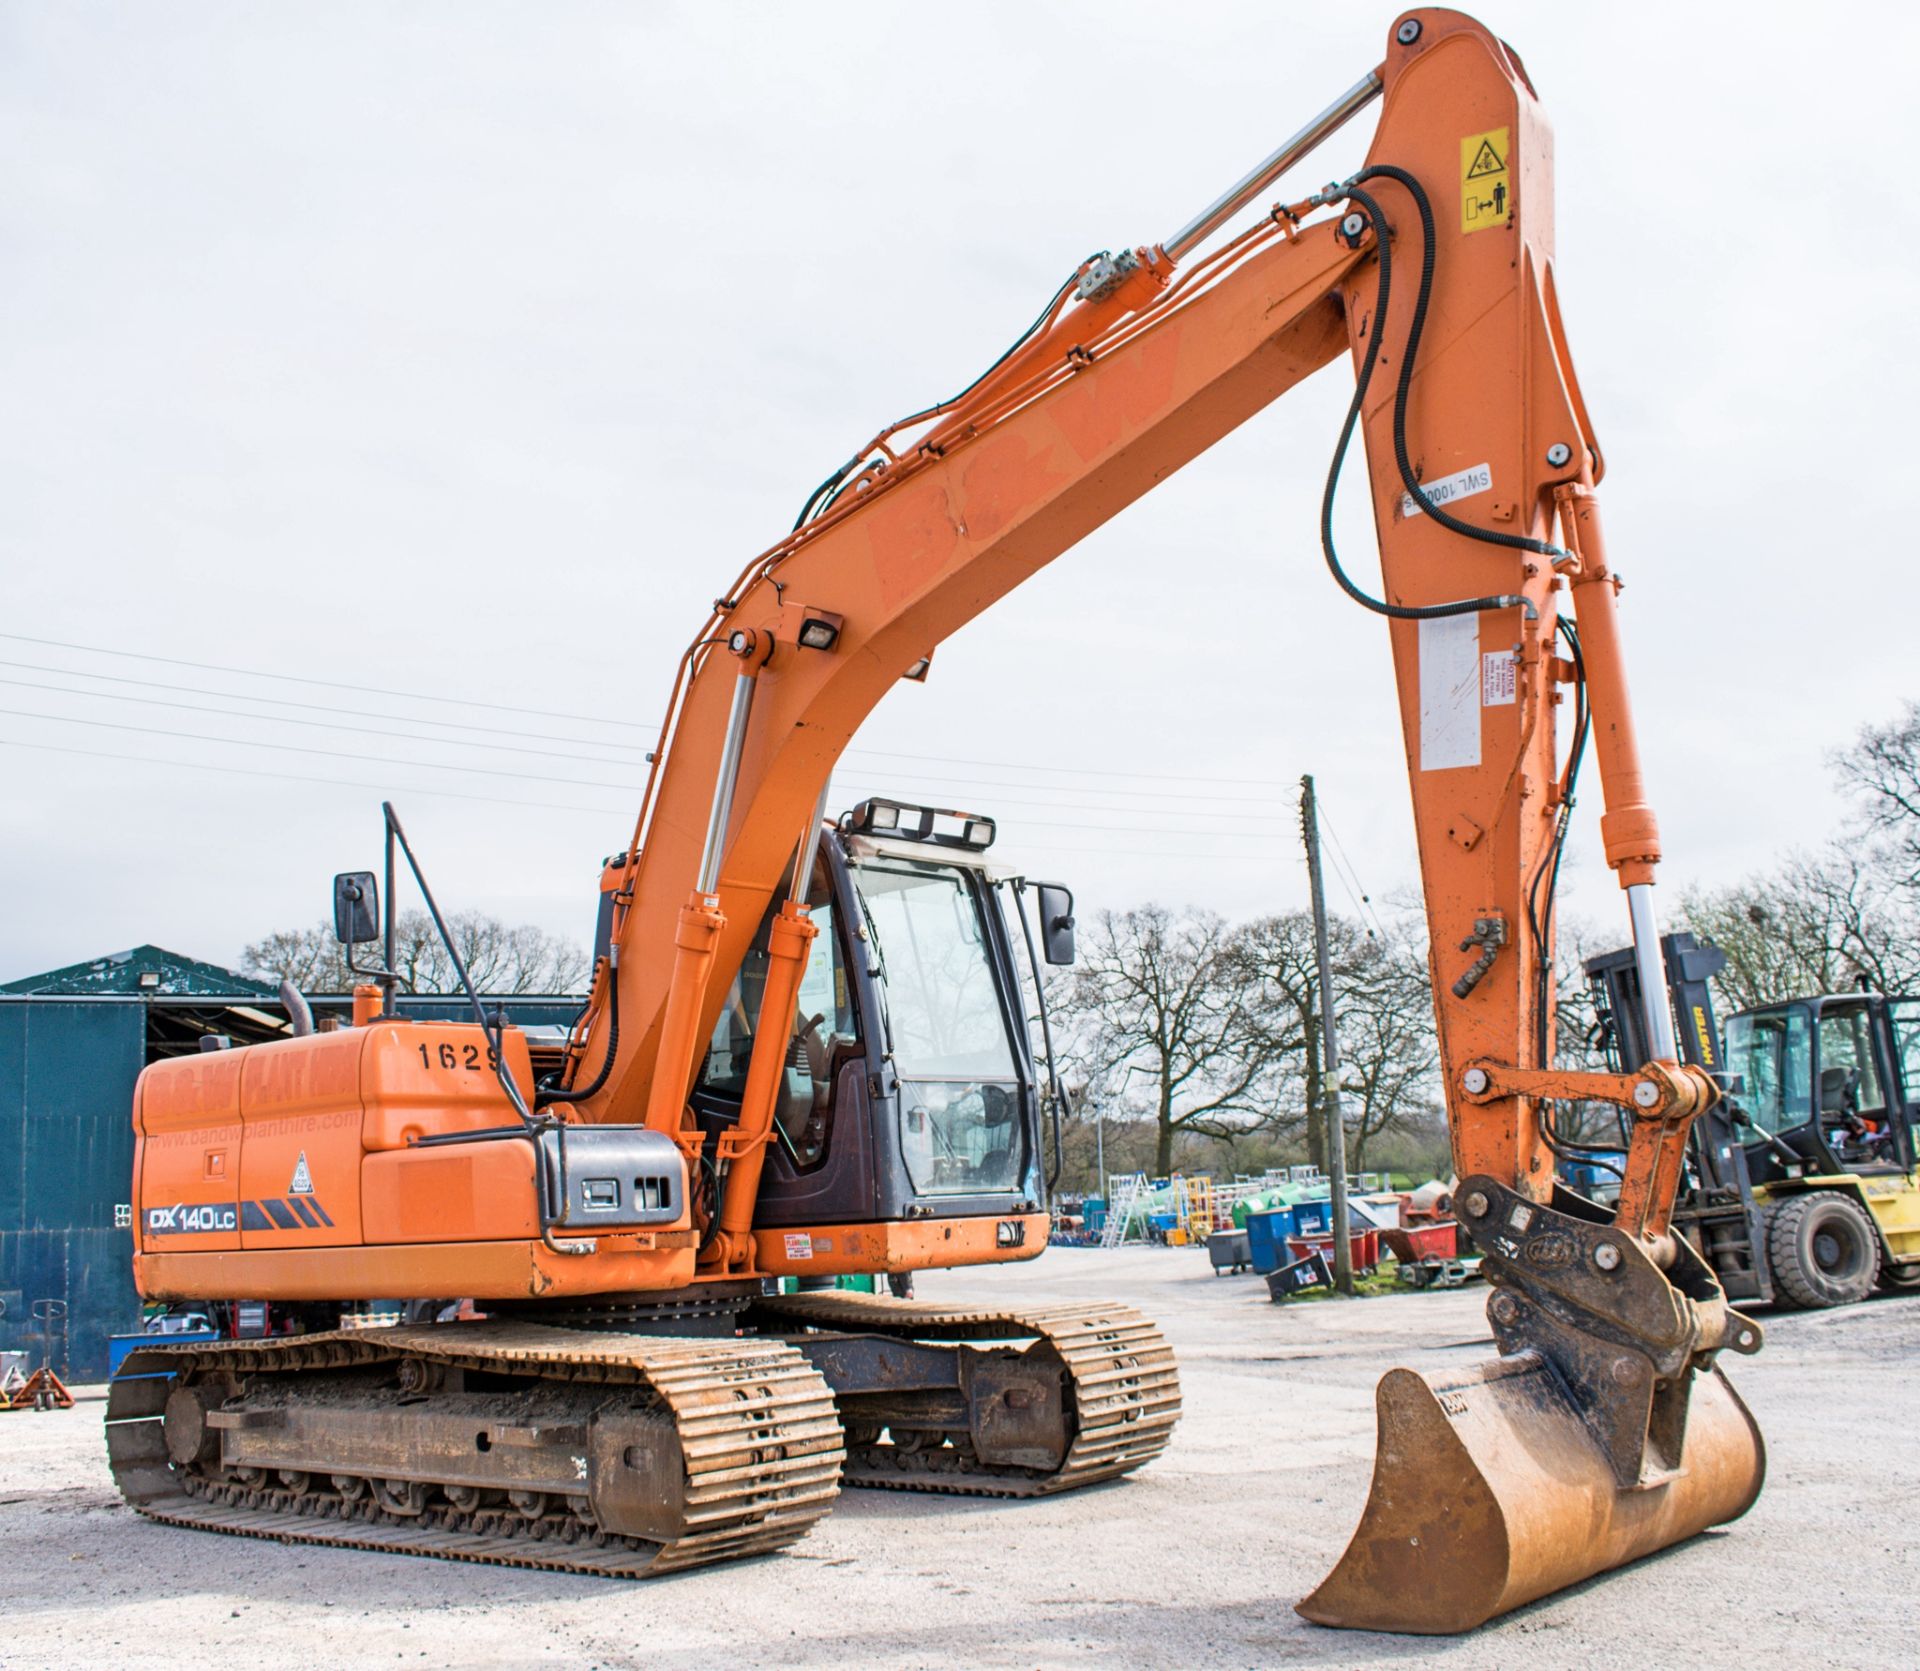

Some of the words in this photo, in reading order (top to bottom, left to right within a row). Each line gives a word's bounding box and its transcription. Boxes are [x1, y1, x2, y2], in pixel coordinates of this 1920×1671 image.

[1458, 471, 1489, 492] SWL
[1506, 658, 1515, 695] NOTICE
[1692, 1005, 1715, 1065] HYSTER
